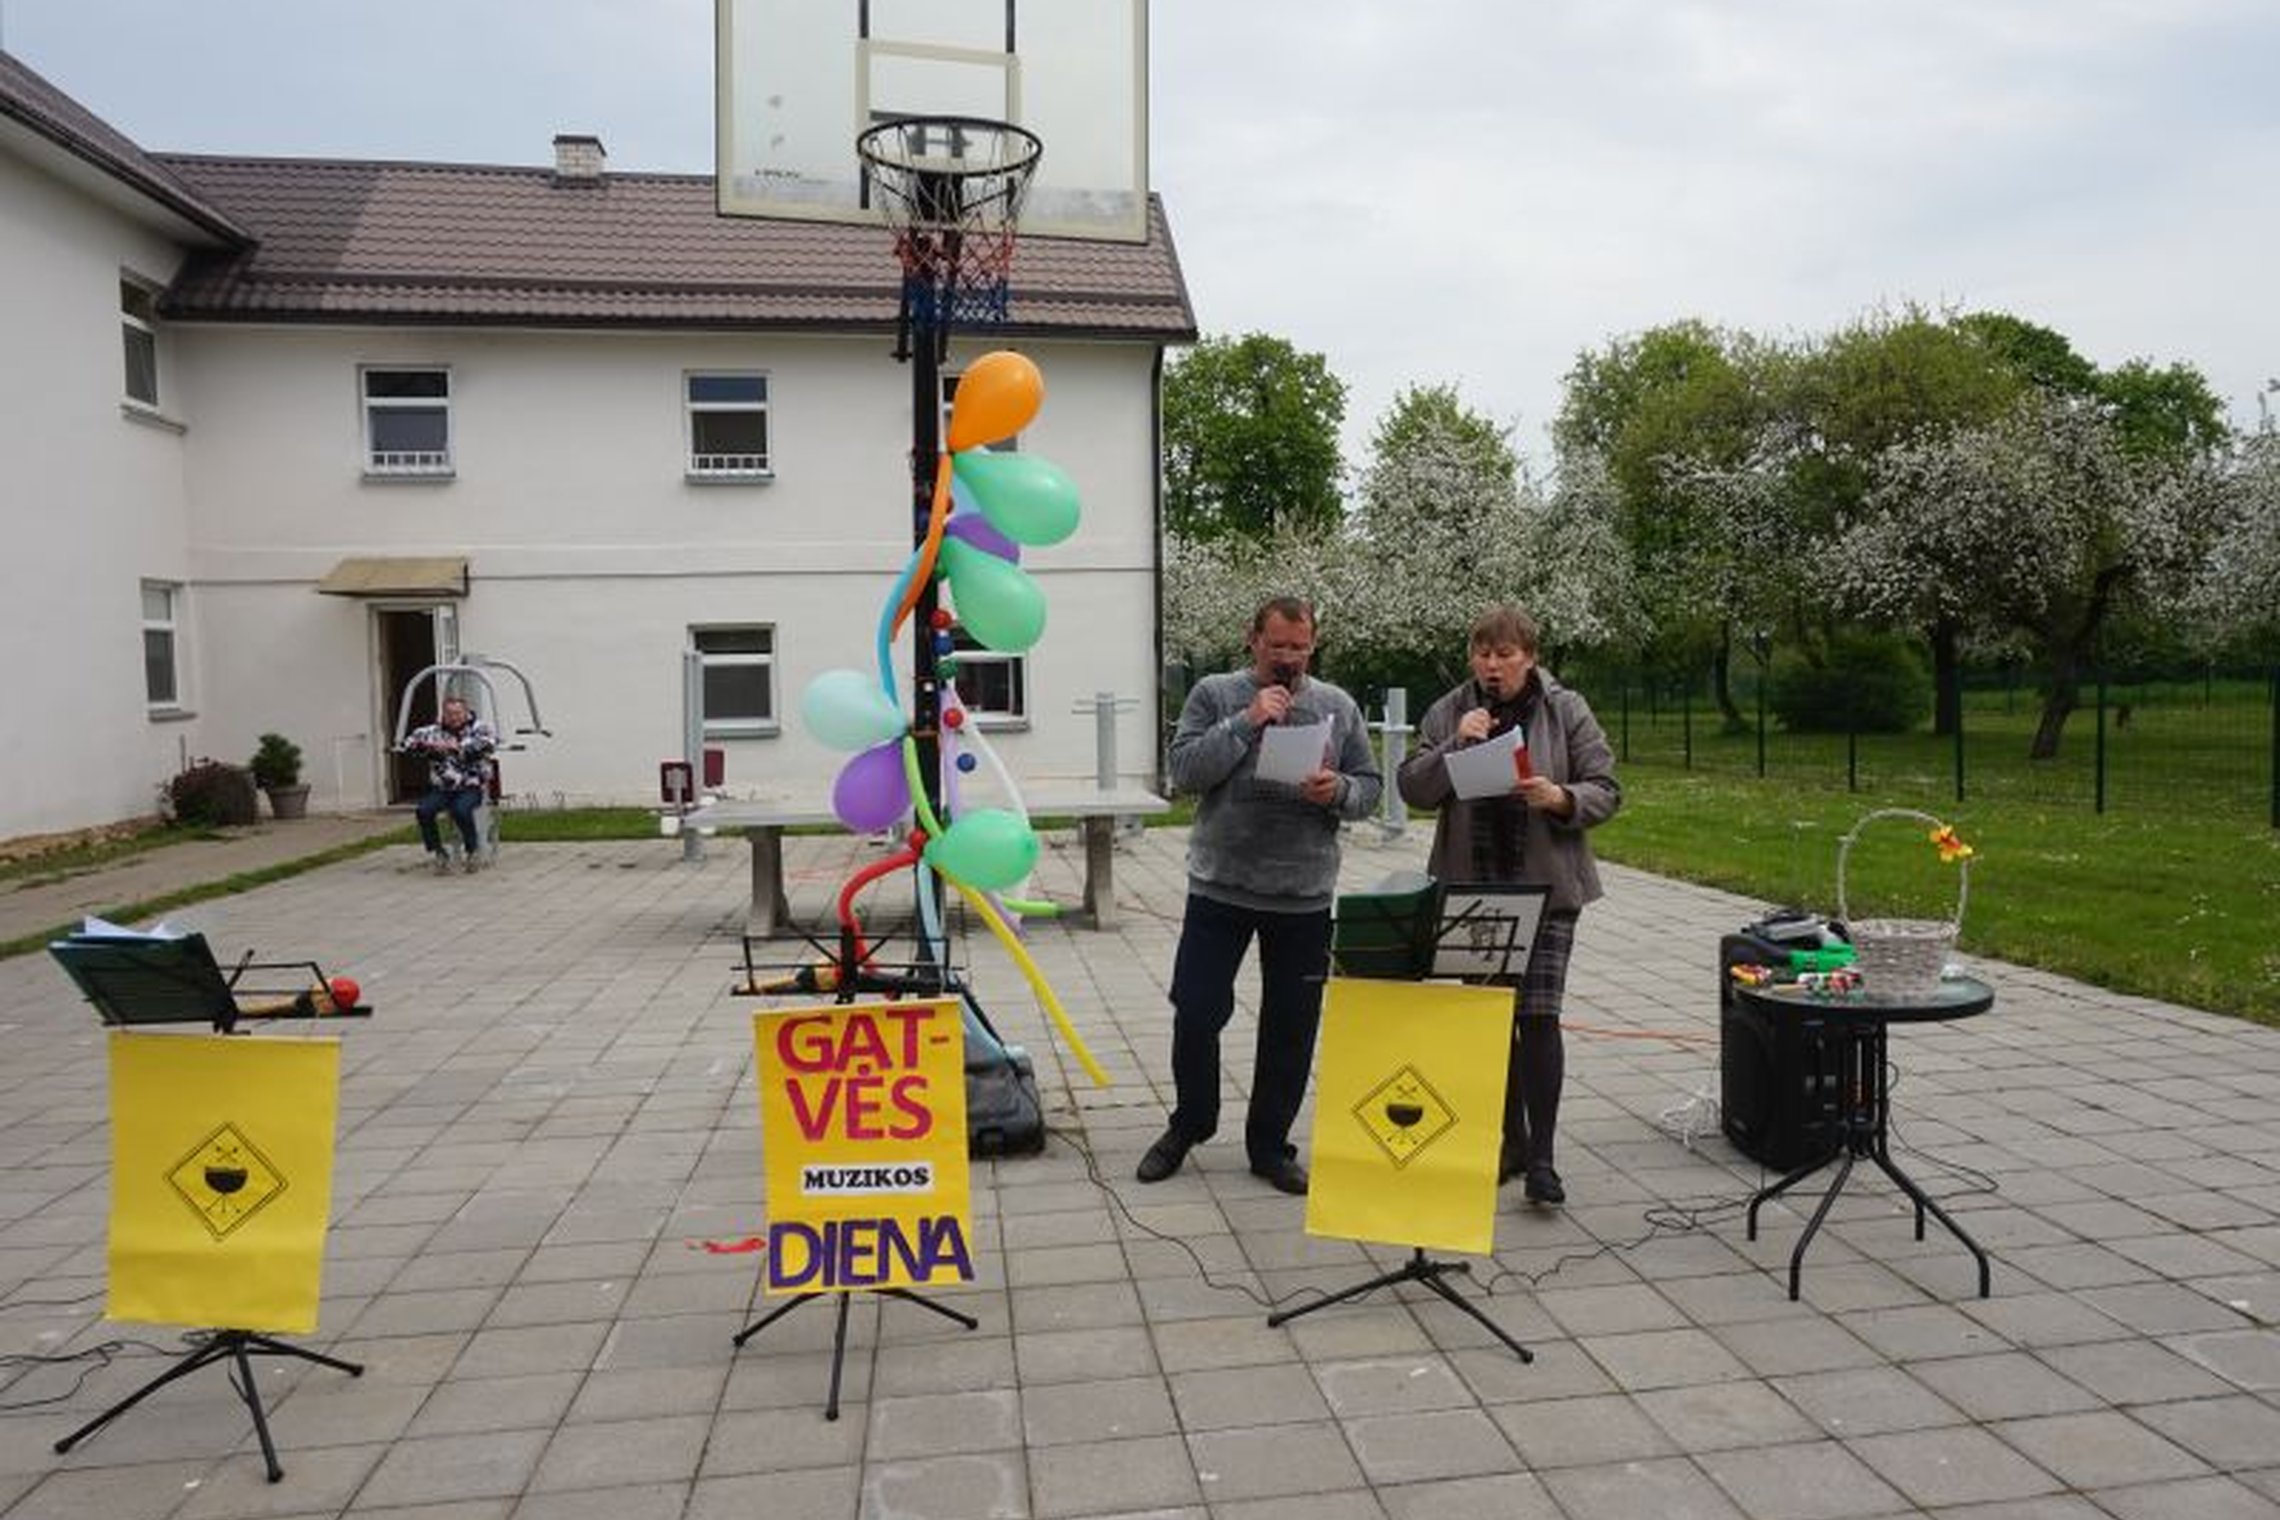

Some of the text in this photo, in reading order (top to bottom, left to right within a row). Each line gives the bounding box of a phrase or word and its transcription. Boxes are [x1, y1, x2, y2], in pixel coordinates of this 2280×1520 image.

[776, 1008, 949, 1074] GAT-
[804, 1166, 929, 1189] MUZIKOS
[768, 1215, 974, 1289] DIENA
